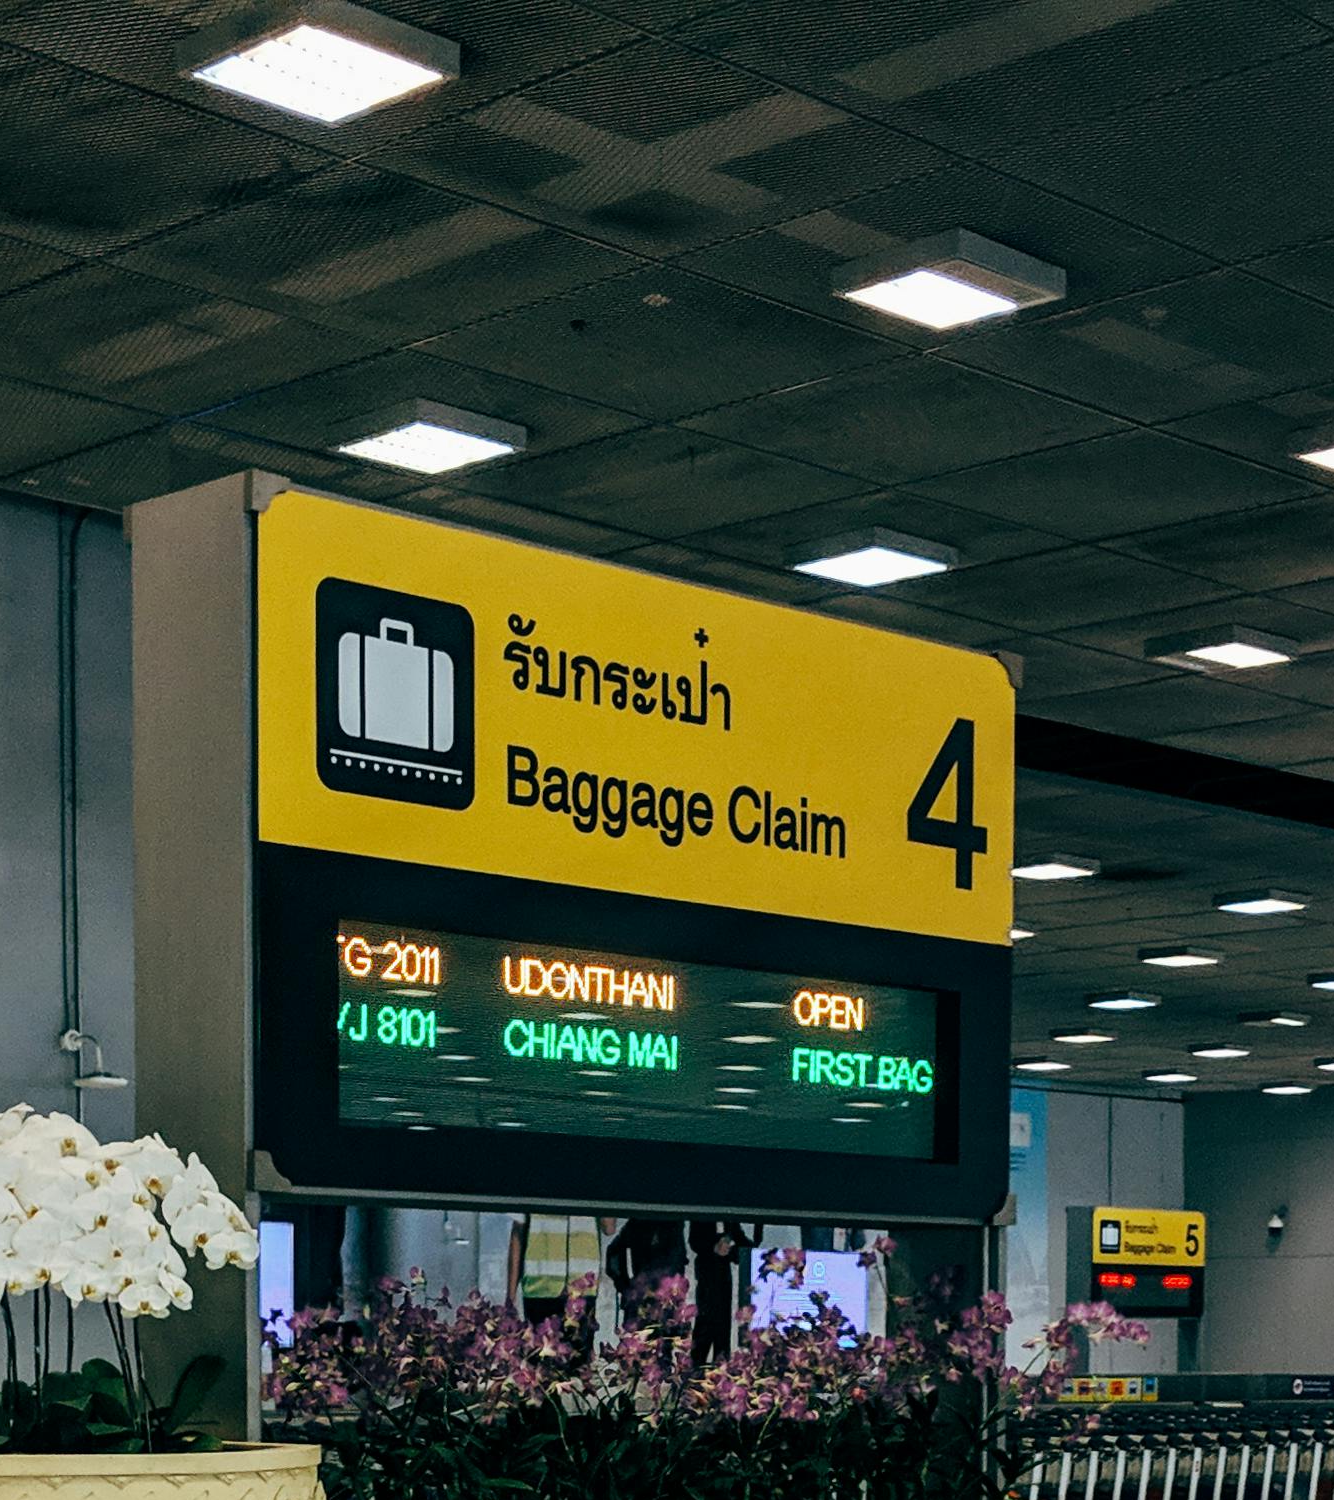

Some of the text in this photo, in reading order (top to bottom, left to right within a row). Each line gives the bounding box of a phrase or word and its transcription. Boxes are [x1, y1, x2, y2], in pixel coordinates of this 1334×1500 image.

[503, 613, 732, 731] รับกระเป๋า
[506, 744, 847, 859] Baggage Claim
[906, 717, 988, 891] 4
[381, 941, 441, 985] 2011
[502, 955, 675, 1011] UDONTHANI
[793, 991, 864, 1032] OPEN
[377, 1006, 436, 1048] 8101
[503, 1019, 621, 1065] CHIANG
[628, 1032, 678, 1071] MAI
[792, 1047, 873, 1087] FIRST
[877, 1056, 934, 1094] BAG
[1185, 1223, 1199, 1257] 5
